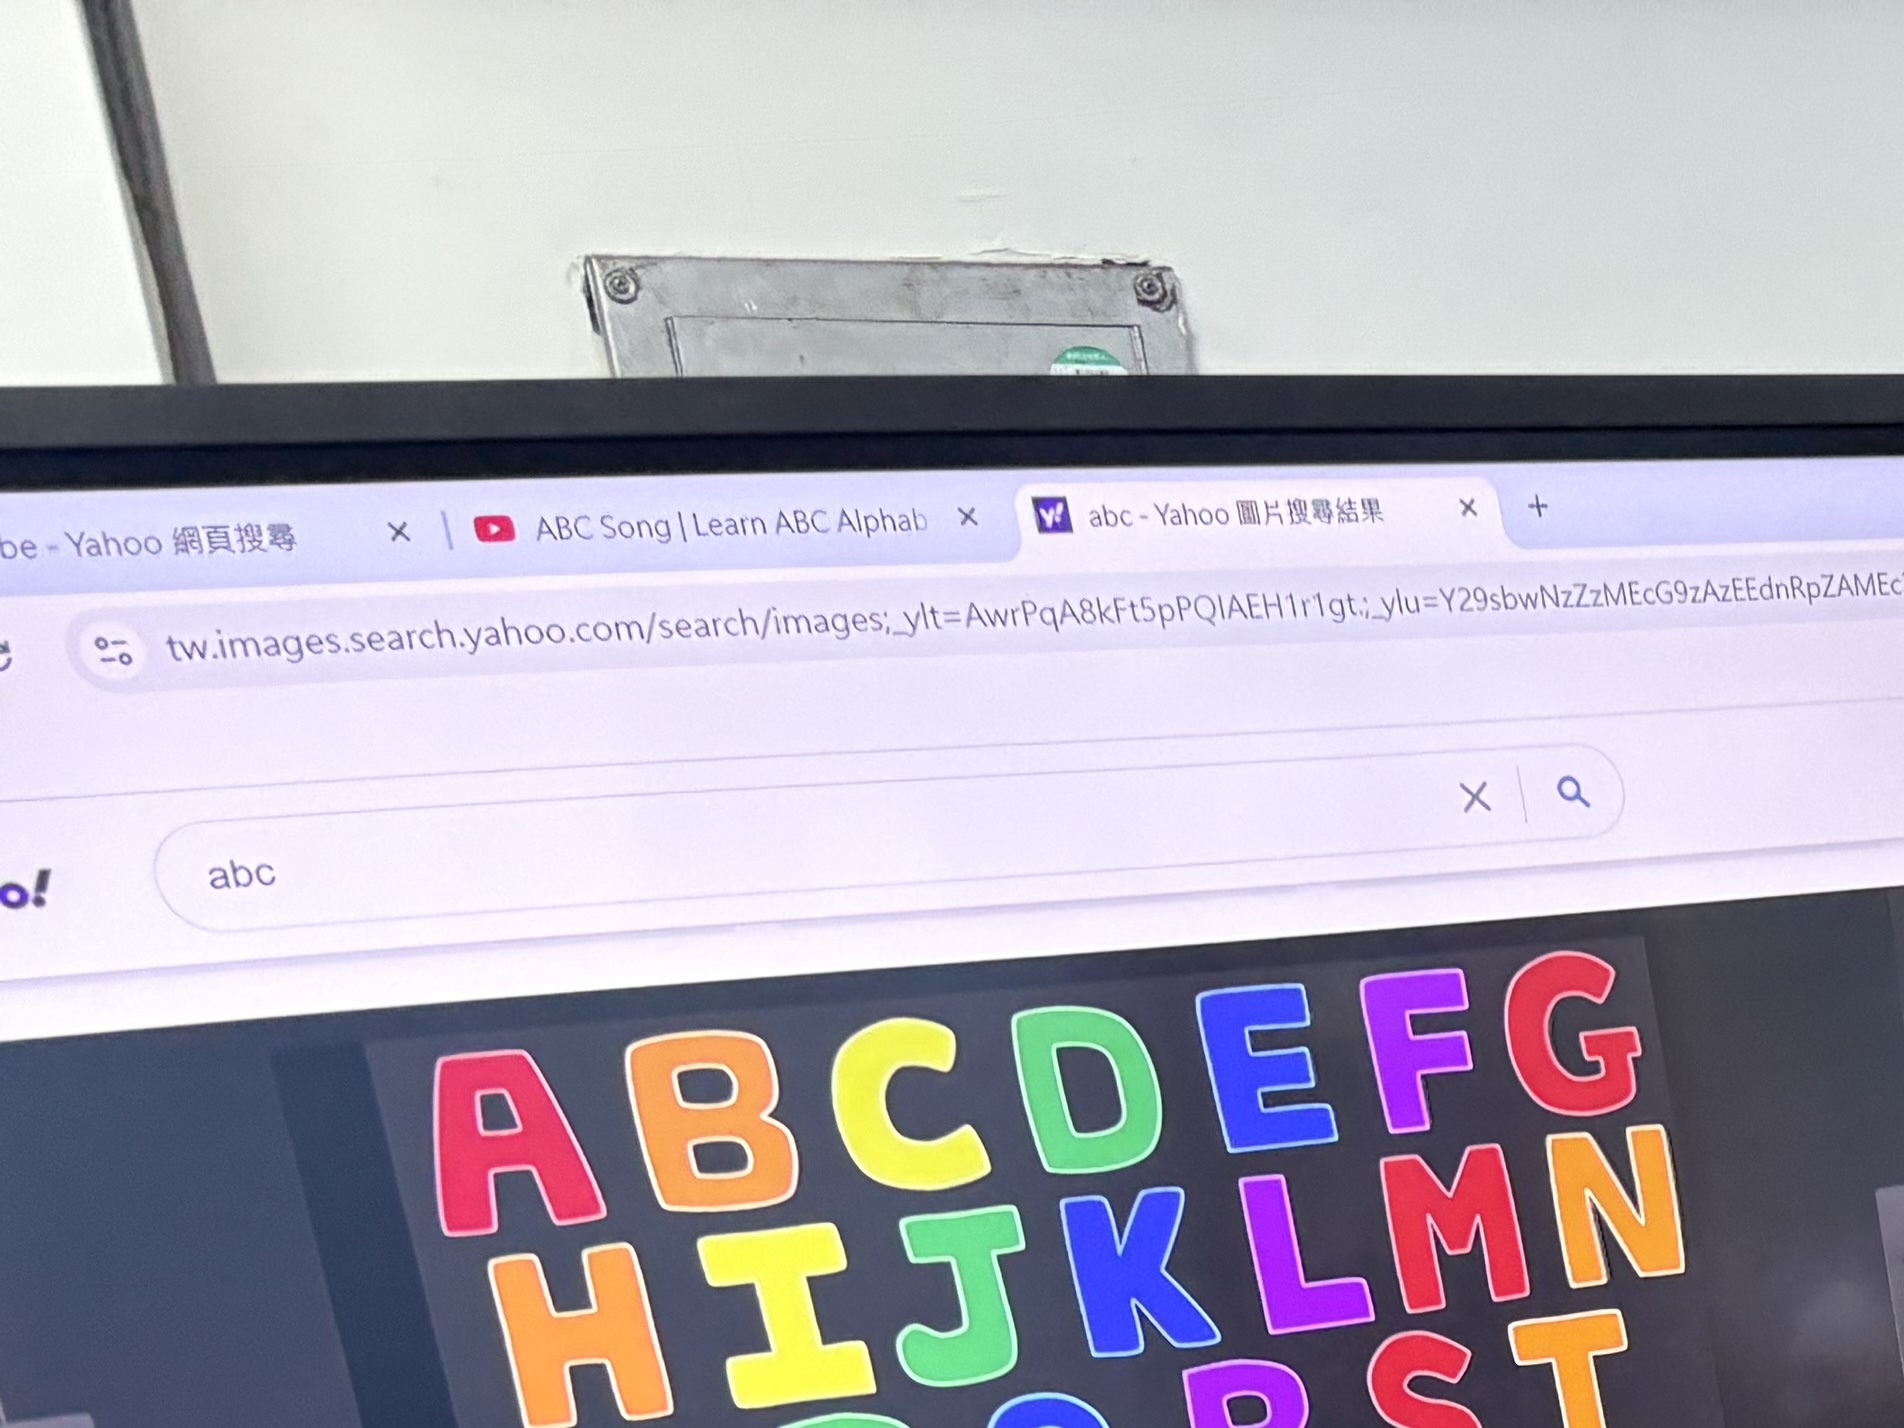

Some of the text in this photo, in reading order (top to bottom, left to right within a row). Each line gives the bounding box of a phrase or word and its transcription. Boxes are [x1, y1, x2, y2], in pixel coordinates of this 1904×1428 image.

[536, 515, 595, 543] ABC
[600, 512, 672, 546] Song
[695, 508, 767, 539] Learn
[775, 507, 831, 537] ABC
[836, 505, 928, 538] Alphab
[1089, 503, 1133, 528] abc
[1153, 500, 1230, 528] Yahoo
[1238, 496, 1385, 527] 圖片搜尋結果
[64, 531, 163, 558] Yahoo
[172, 523, 297, 556] 網頁搜尋
[209, 859, 276, 890] abc
[432, 949, 1642, 1235] A B C D E F G
[696, 1222, 878, 1410] I
[896, 1205, 1023, 1387] J
[1060, 1187, 1221, 1358] K
[1237, 1175, 1375, 1335] L
[1380, 1143, 1531, 1313] M
[1547, 1124, 1687, 1289] N
